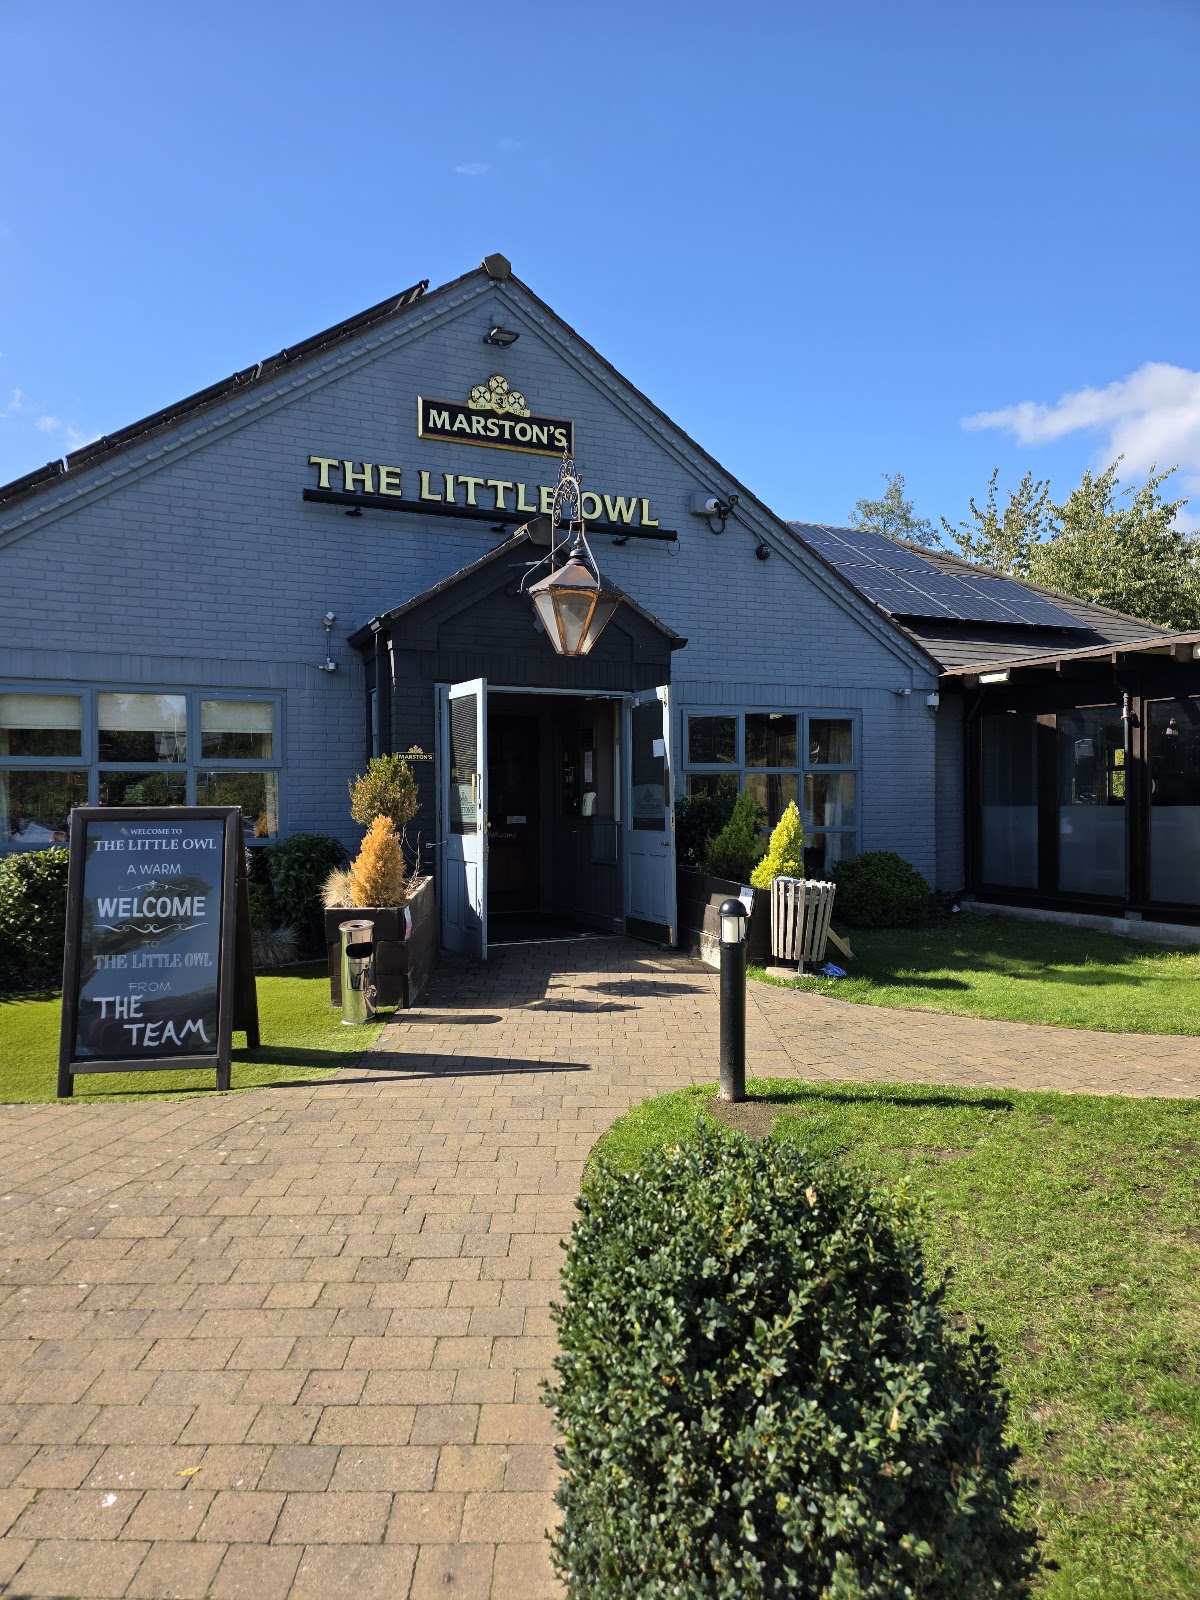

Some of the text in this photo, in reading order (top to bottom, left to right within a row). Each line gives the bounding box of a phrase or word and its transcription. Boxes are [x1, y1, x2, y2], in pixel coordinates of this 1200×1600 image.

[428, 408, 567, 447] MARSTON'S
[308, 455, 660, 528] THE LITTLE OWL
[93, 838, 217, 852] THE LITTLE OWL
[126, 863, 182, 875] A WARM
[97, 896, 206, 918] WELCOME
[143, 940, 160, 948] TO
[92, 952, 213, 970] THE LITTLE OWL
[128, 981, 171, 992] FROM
[92, 994, 144, 1020] THE
[123, 1018, 212, 1047] TEAM
